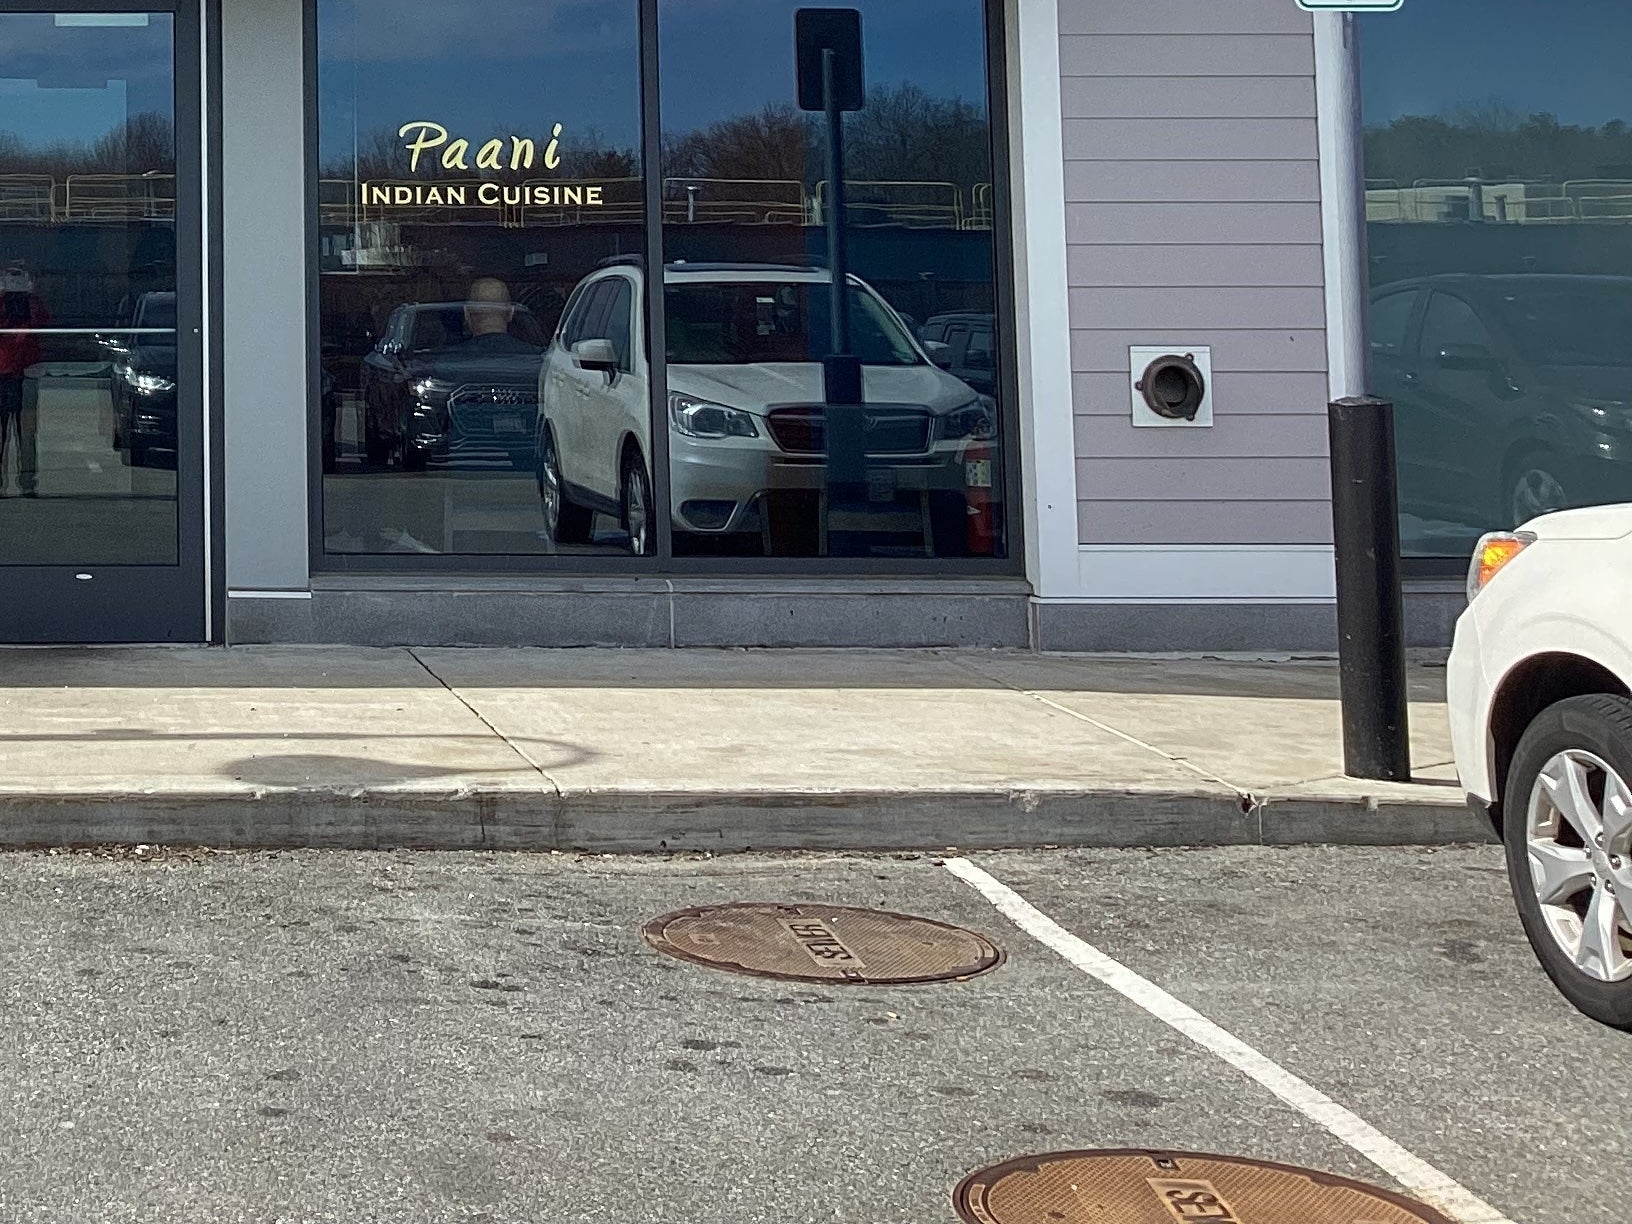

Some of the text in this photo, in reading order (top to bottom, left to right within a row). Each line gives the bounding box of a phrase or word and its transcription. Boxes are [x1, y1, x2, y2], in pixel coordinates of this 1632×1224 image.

[398, 121, 562, 173] Paani
[361, 182, 603, 205] INDIAN CUISINE
